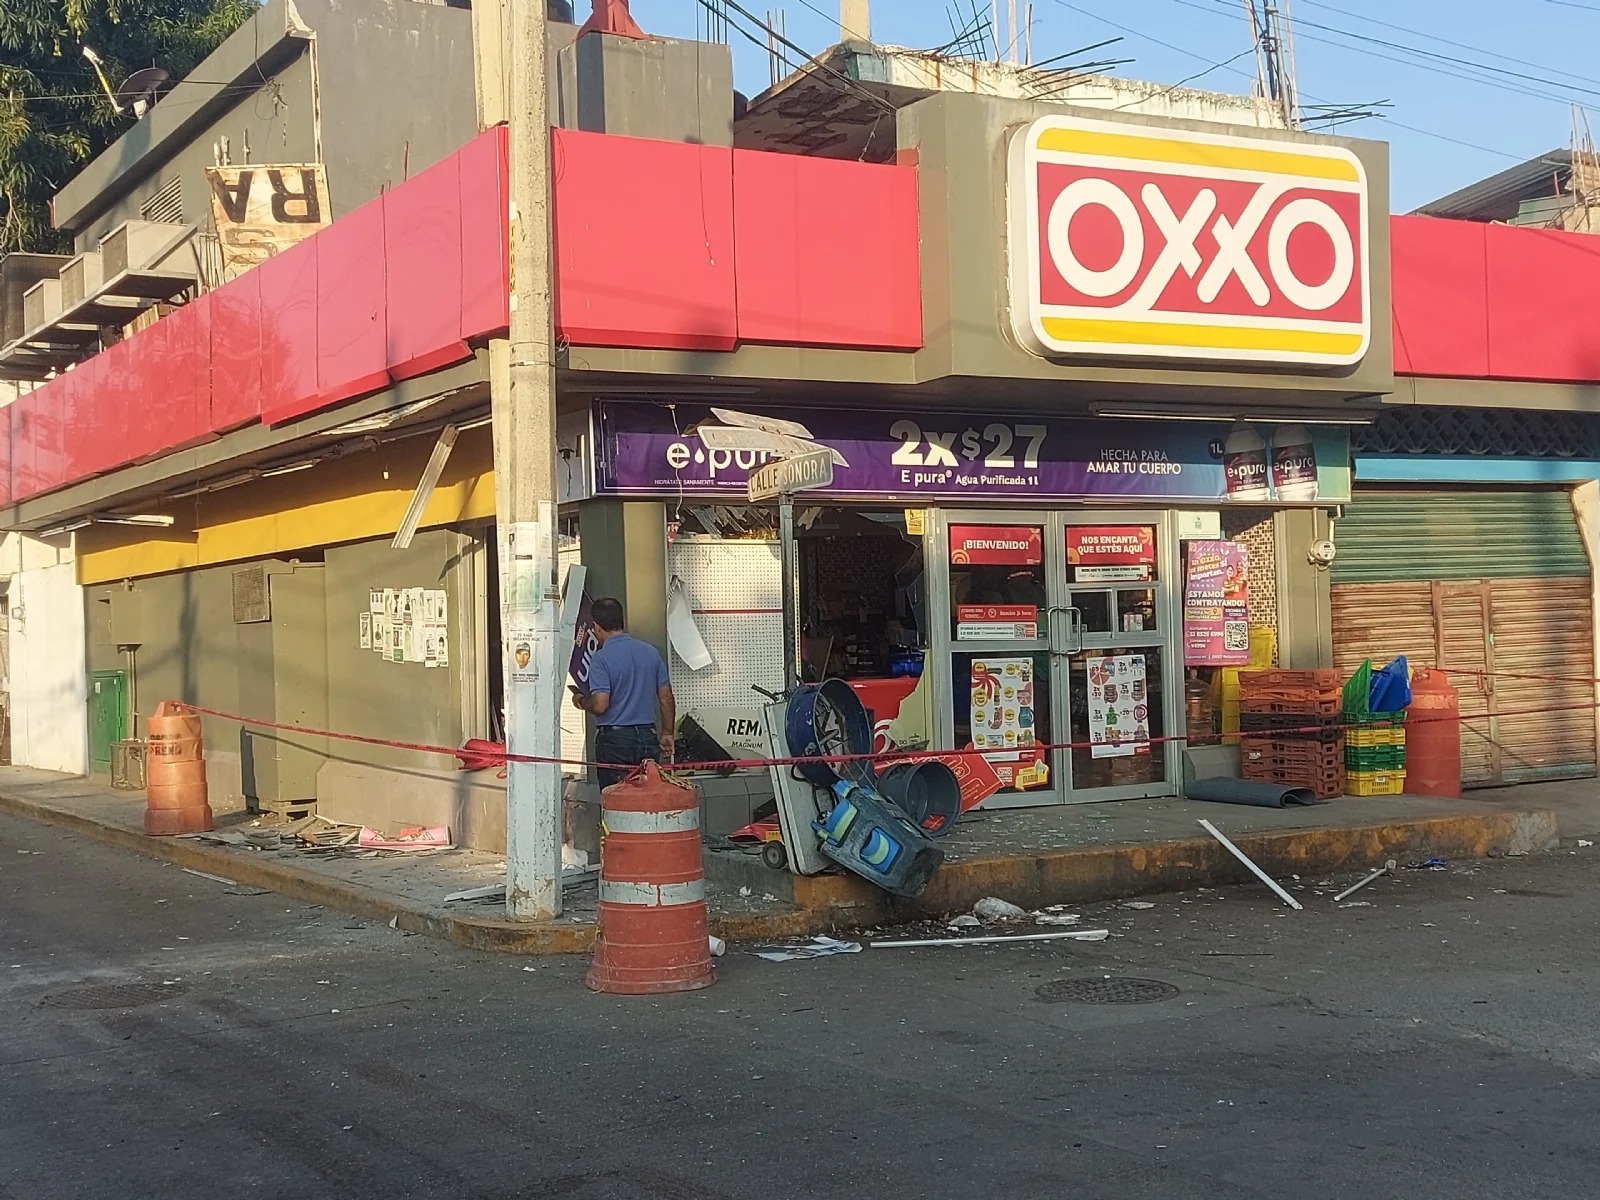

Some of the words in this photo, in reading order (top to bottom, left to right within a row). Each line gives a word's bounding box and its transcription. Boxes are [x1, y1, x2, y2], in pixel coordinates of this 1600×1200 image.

[1047, 178, 1354, 311] OXXO
[1100, 449, 1138, 462] HECHA
[1141, 449, 1168, 462] PARA
[1087, 461, 1121, 474] AMAR
[1122, 462, 1136, 474] TU
[1139, 462, 1182, 475] CUERPO
[750, 468, 779, 493] CALLE
[783, 457, 828, 484] SONORA
[901, 470, 911, 483] E
[955, 475, 979, 486] Agua
[980, 475, 1026, 485] Purificada
[963, 540, 1029, 551] ¡BIENVENIDO!
[1081, 535, 1099, 544] NOS
[1100, 535, 1138, 544] ENCANTA
[1077, 545, 1095, 555] QUE
[731, 741, 764, 749] MAGNUM
